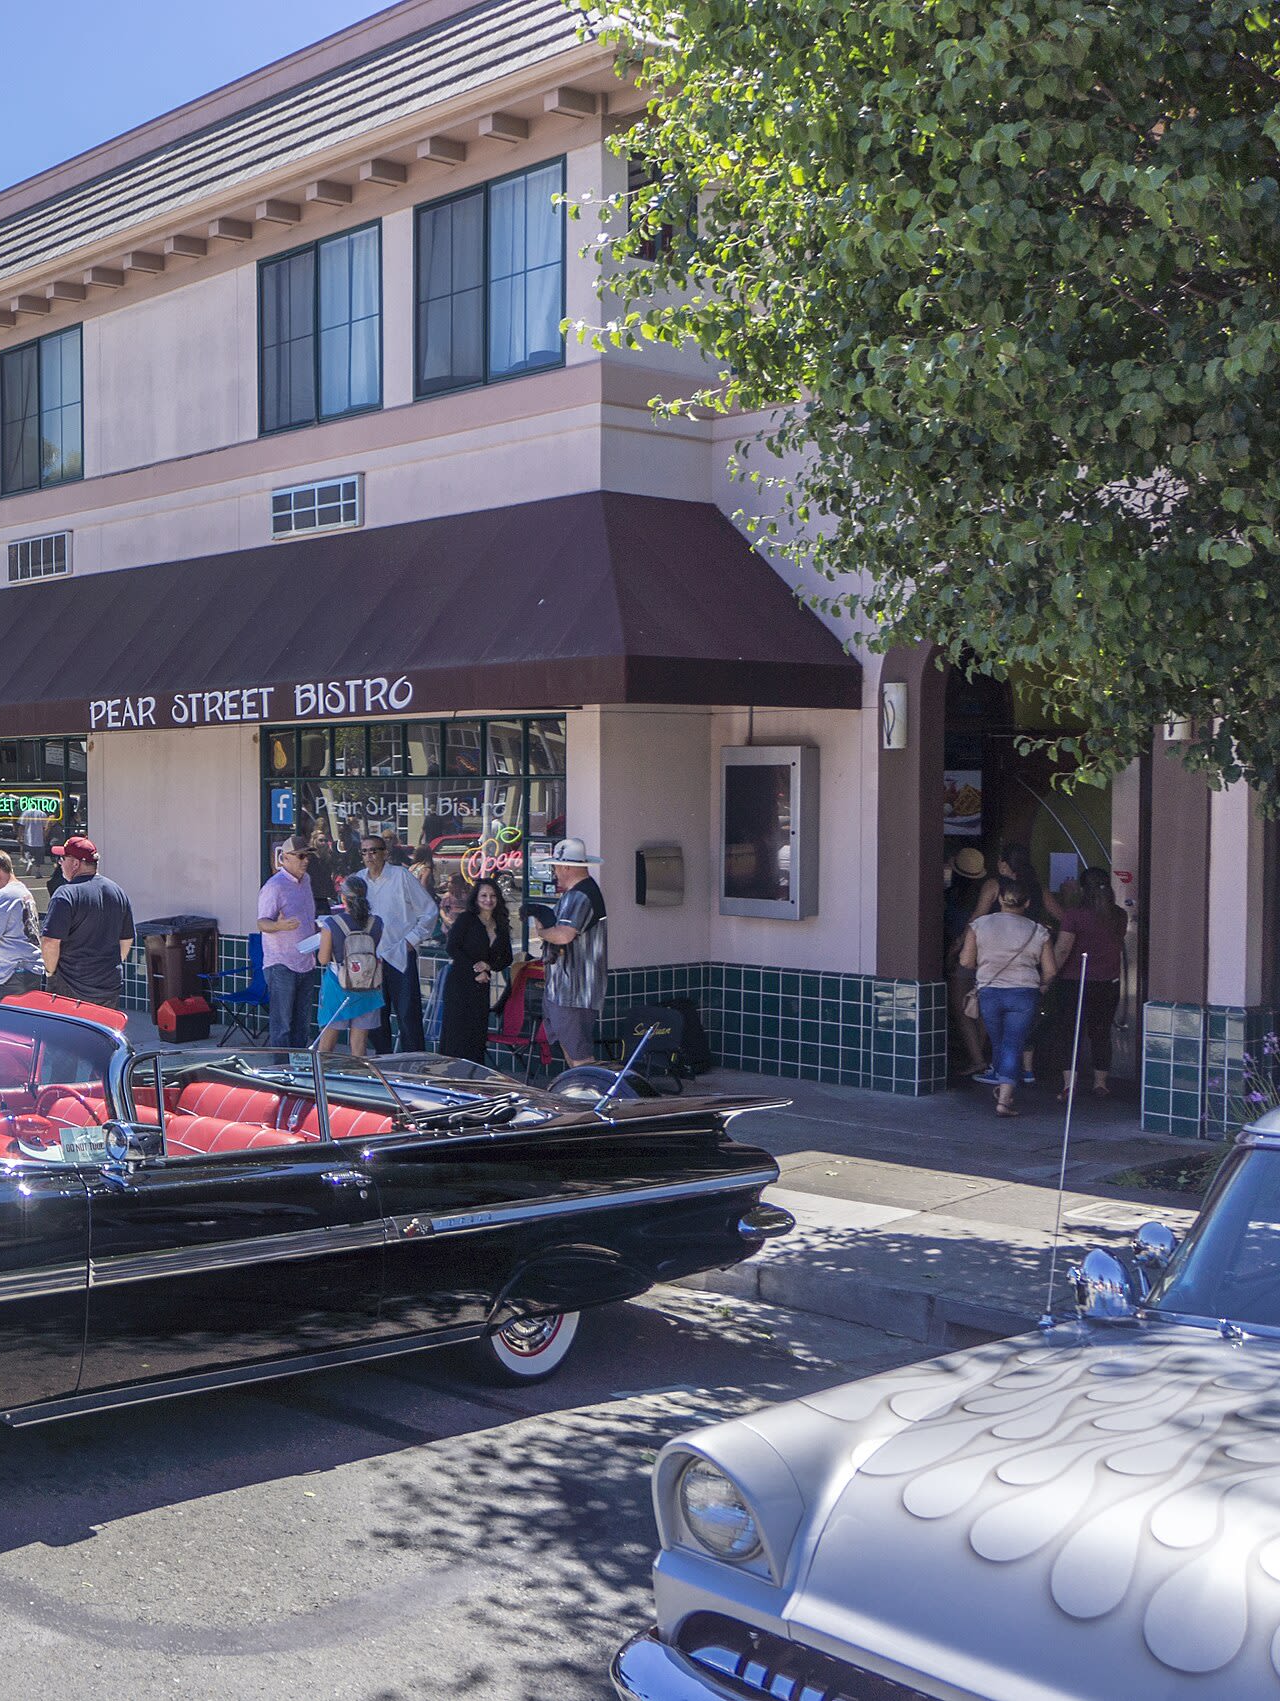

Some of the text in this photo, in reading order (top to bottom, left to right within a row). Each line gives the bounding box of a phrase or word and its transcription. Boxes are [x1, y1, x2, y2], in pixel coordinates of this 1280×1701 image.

[89, 675, 413, 729] PEAR STREET BISTRO
[19, 796, 58, 813] BISTRO
[315, 796, 507, 818] Pear Street Bistro
[467, 850, 523, 878] Open
[65, 1141, 105, 1153] DO NOT TOUC
